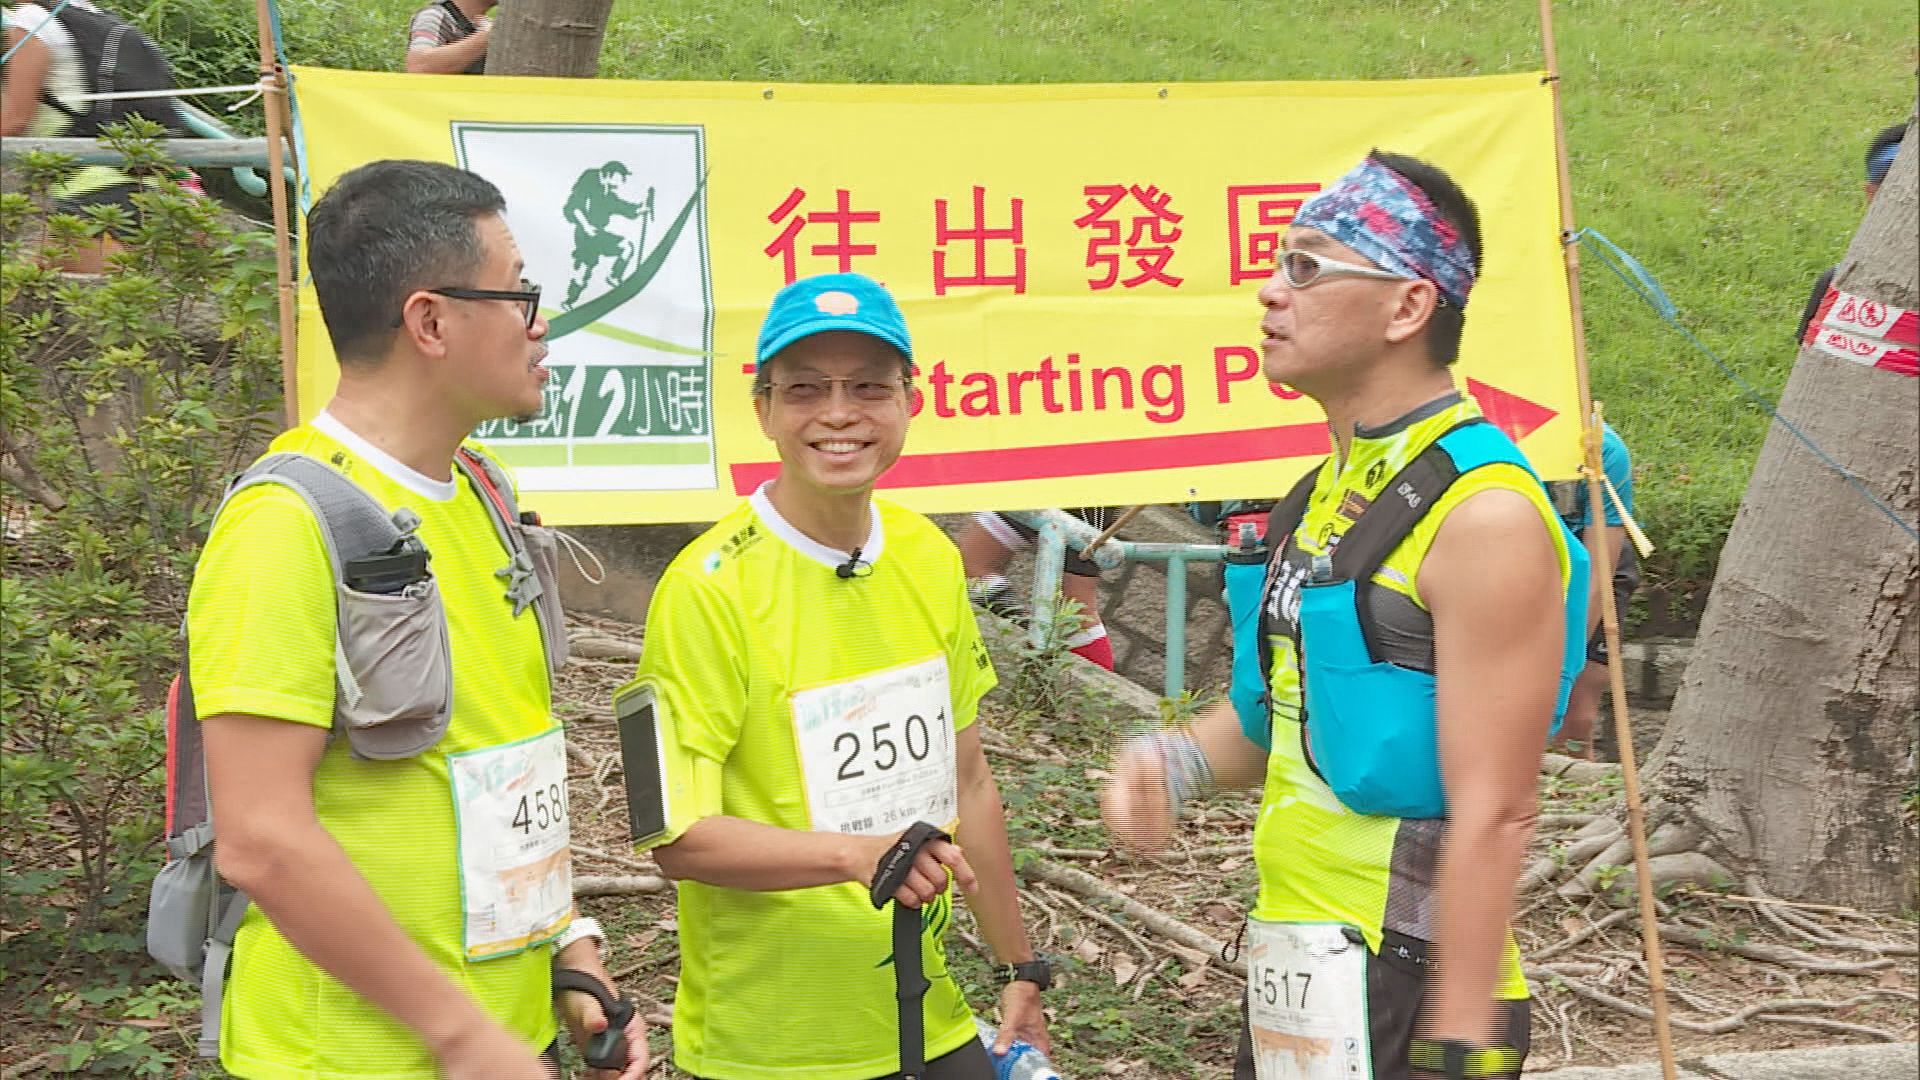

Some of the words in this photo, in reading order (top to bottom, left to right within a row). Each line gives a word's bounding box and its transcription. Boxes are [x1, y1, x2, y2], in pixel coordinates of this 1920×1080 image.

[764, 184, 1322, 297] 往出發區
[833, 705, 949, 782] 2501
